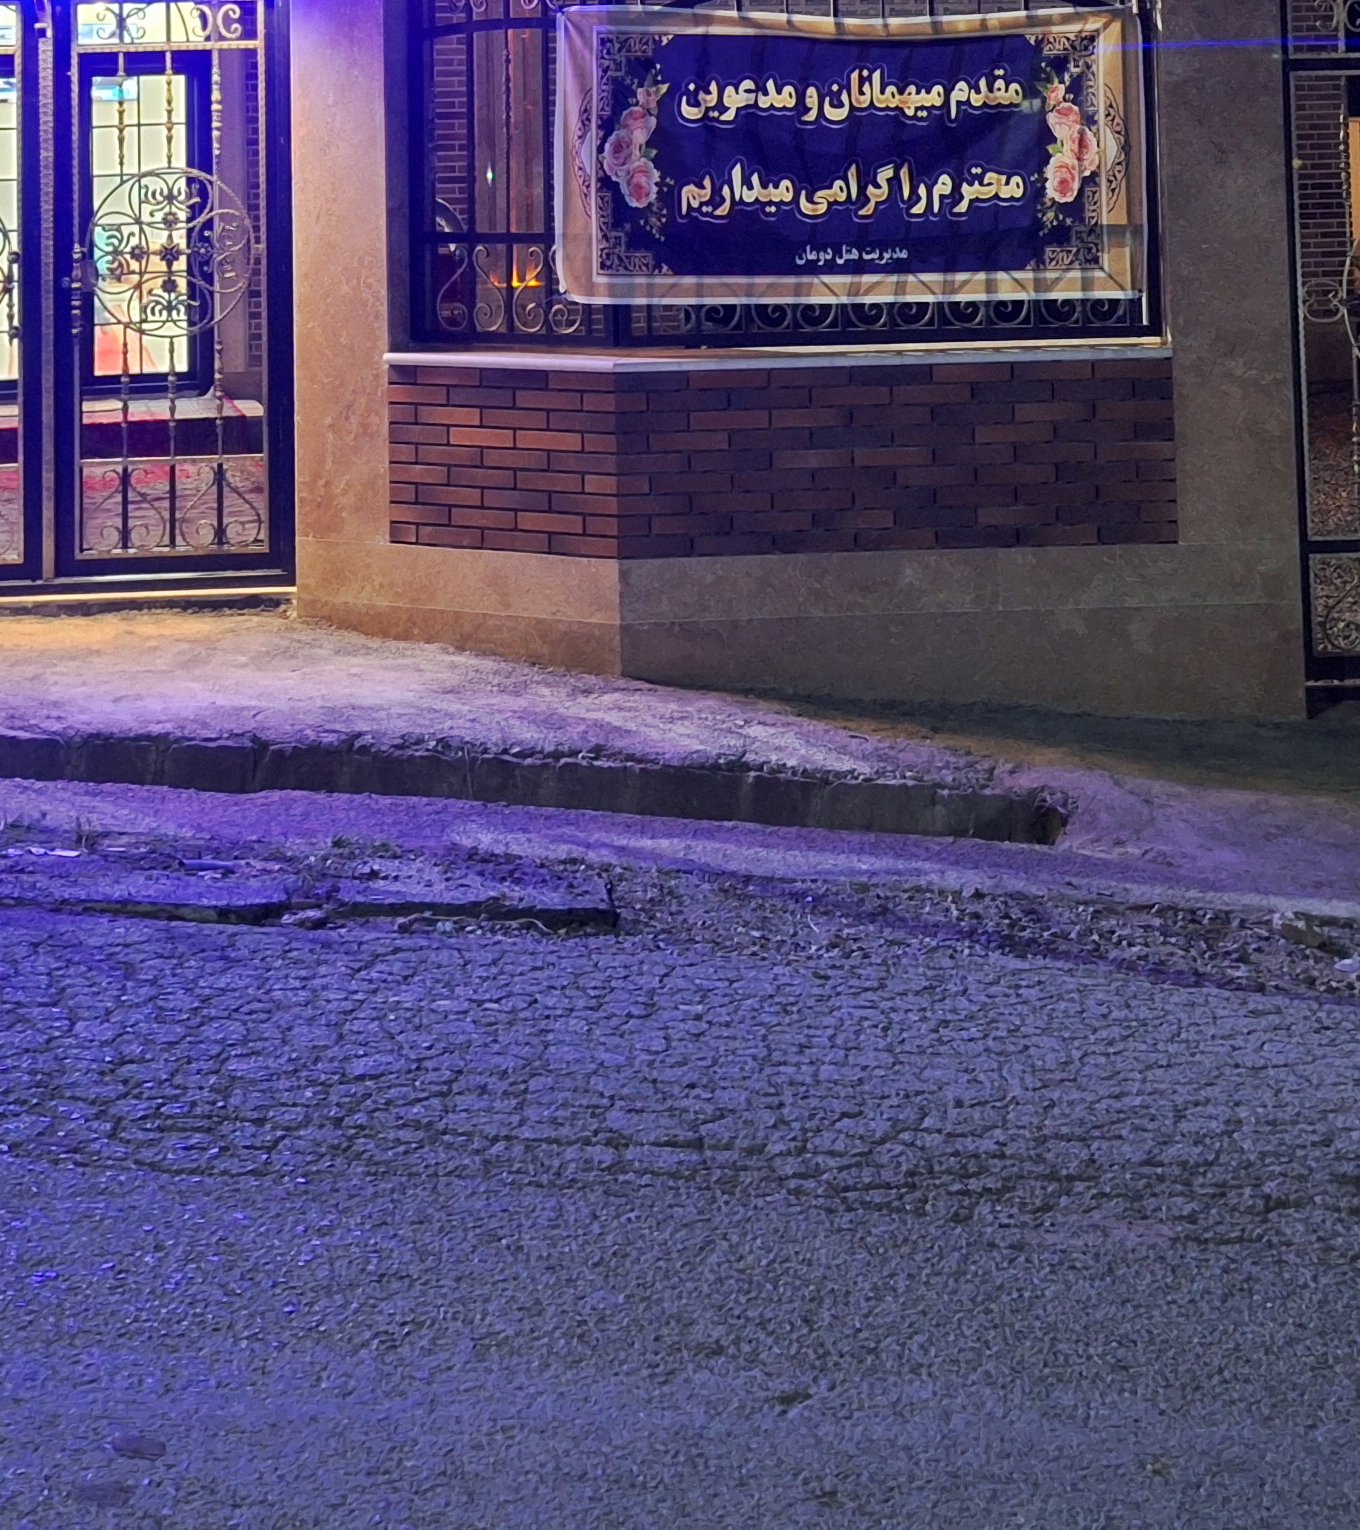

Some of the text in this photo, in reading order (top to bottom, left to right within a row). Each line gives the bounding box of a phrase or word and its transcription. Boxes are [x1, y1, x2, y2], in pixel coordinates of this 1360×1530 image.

[680, 68, 1024, 122] مقدم میهمانان و مدعوین
[680, 162, 1025, 216] محترم را گرامی میداریم
[795, 244, 908, 266] مدیریت هتل دومان
